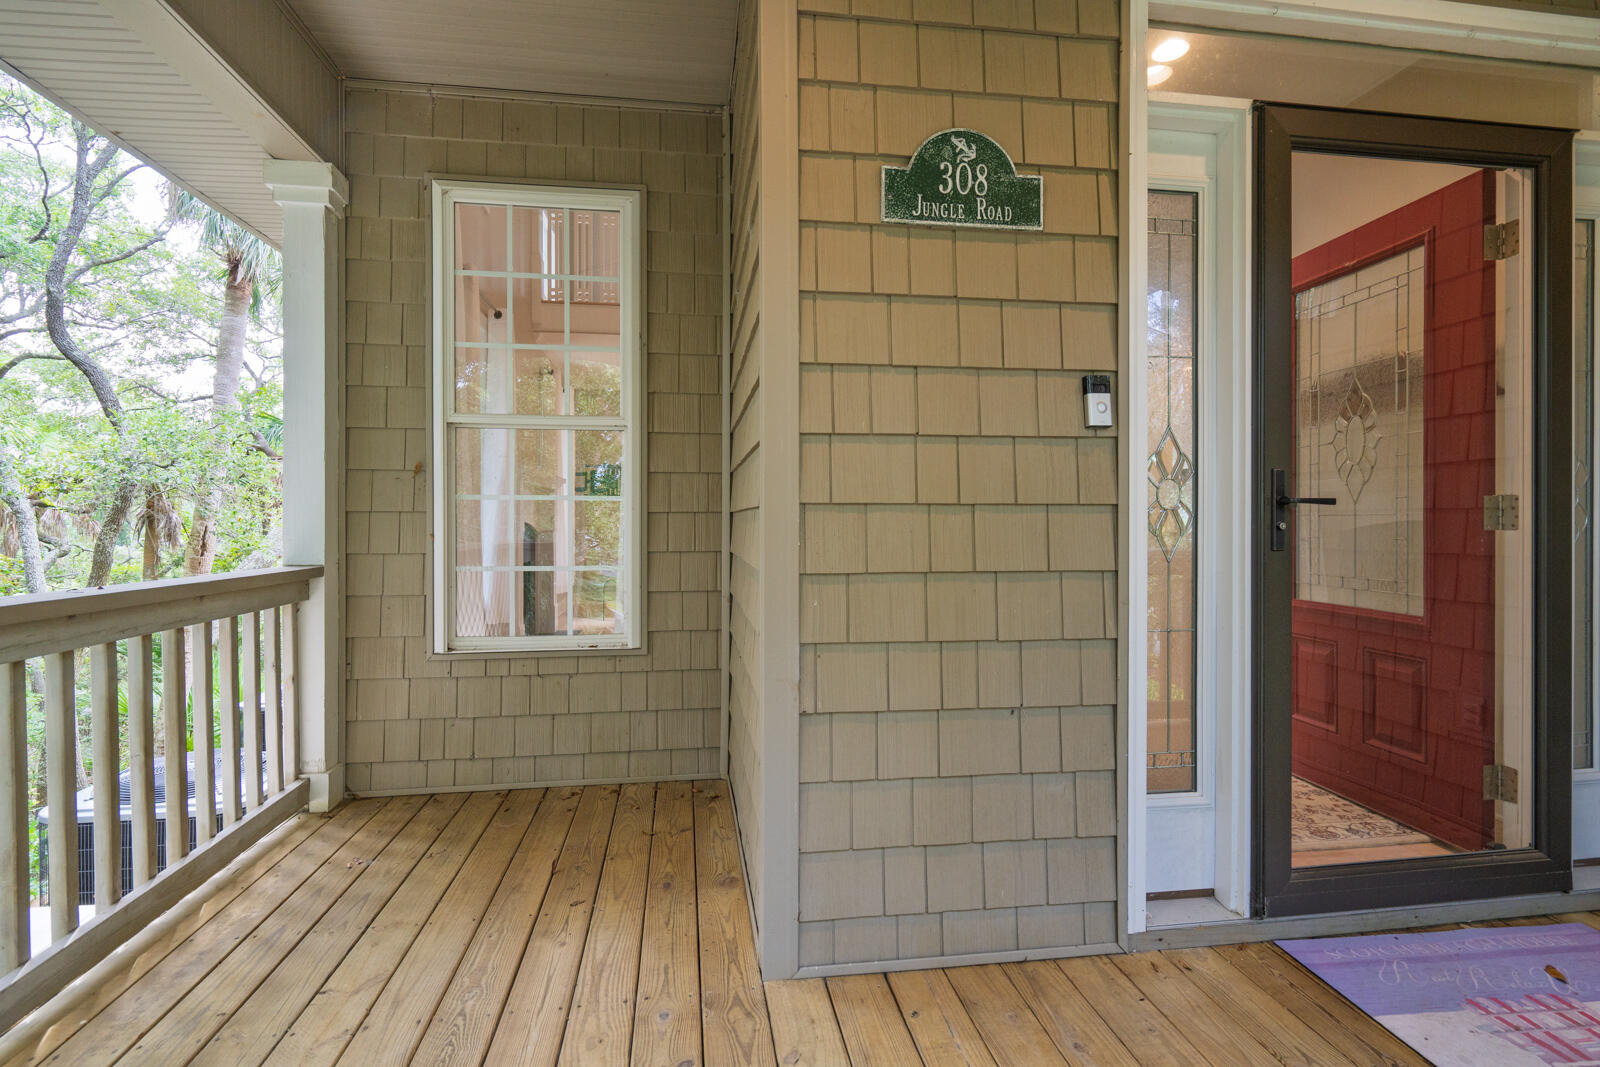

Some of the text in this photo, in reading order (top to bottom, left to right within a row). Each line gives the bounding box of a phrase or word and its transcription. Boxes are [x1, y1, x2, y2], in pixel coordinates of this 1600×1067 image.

[938, 161, 988, 196] 308
[912, 194, 1012, 221] JUNGLE ROAD
